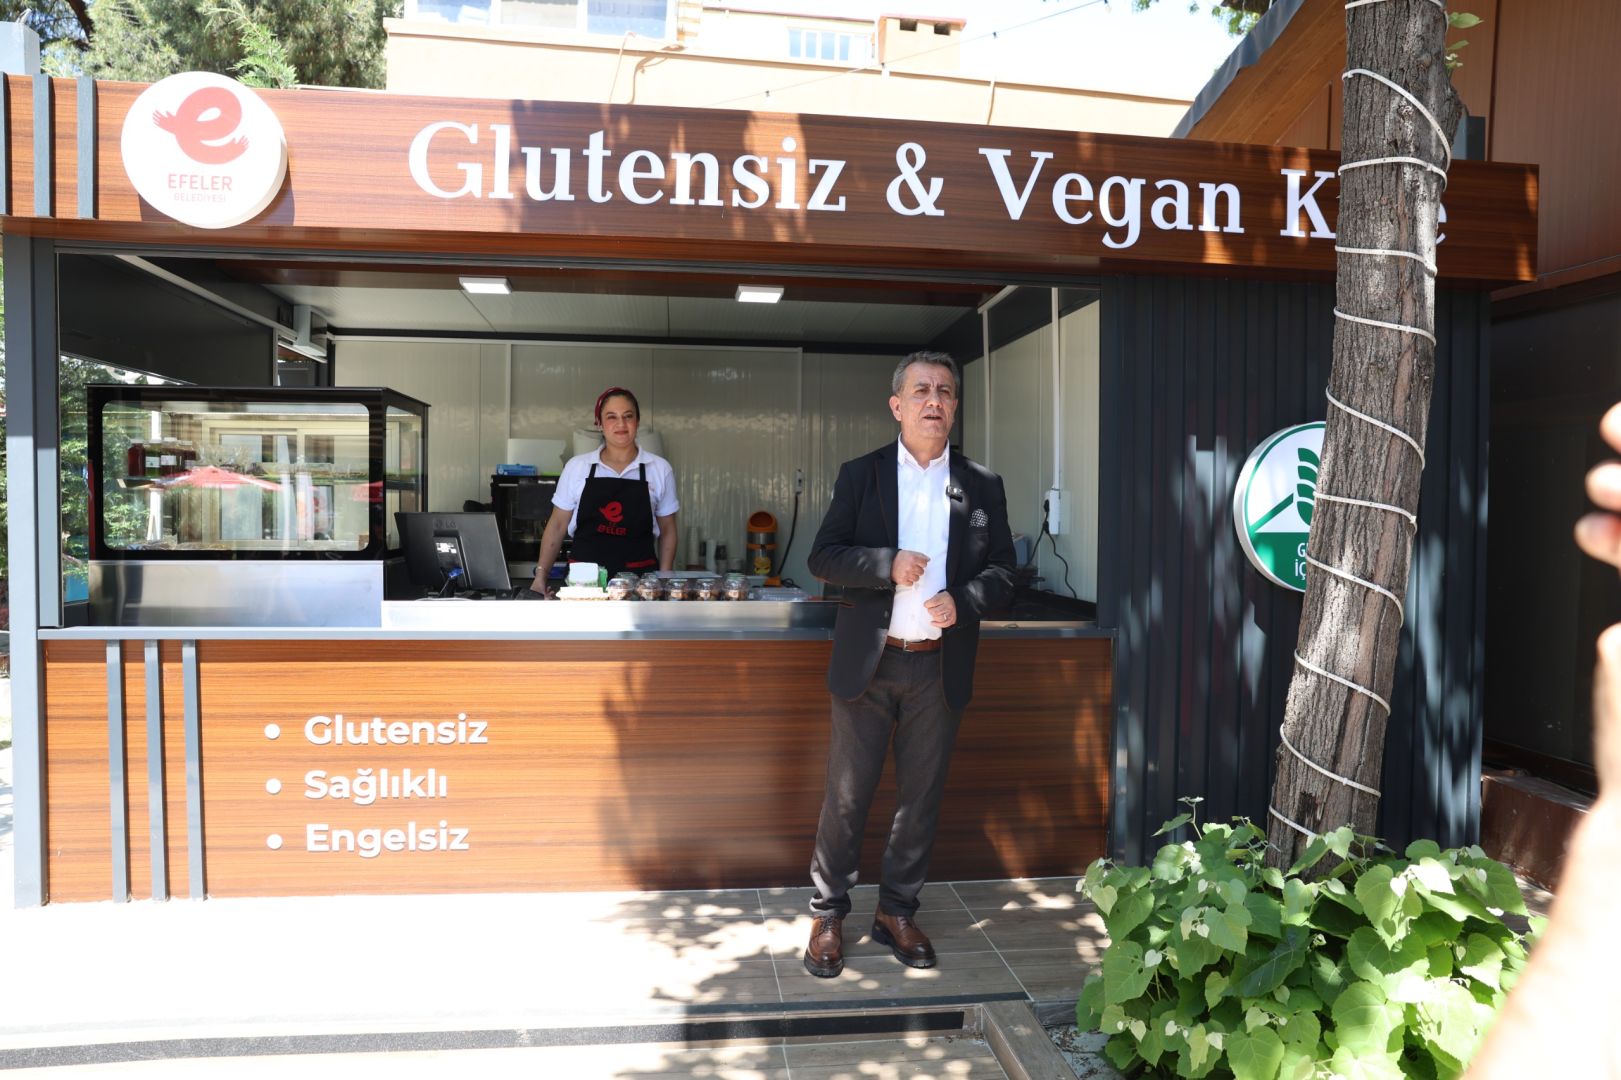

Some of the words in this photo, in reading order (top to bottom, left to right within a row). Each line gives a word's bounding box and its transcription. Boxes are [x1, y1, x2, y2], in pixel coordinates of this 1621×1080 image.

[168, 173, 233, 191] EFELER
[405, 118, 846, 212] Glutensiz
[887, 142, 945, 217] &
[978, 147, 1244, 249] Vegan
[304, 712, 488, 745] Glutensiz
[303, 767, 448, 805] Sağlıklı
[305, 819, 470, 858] Engelsiz
